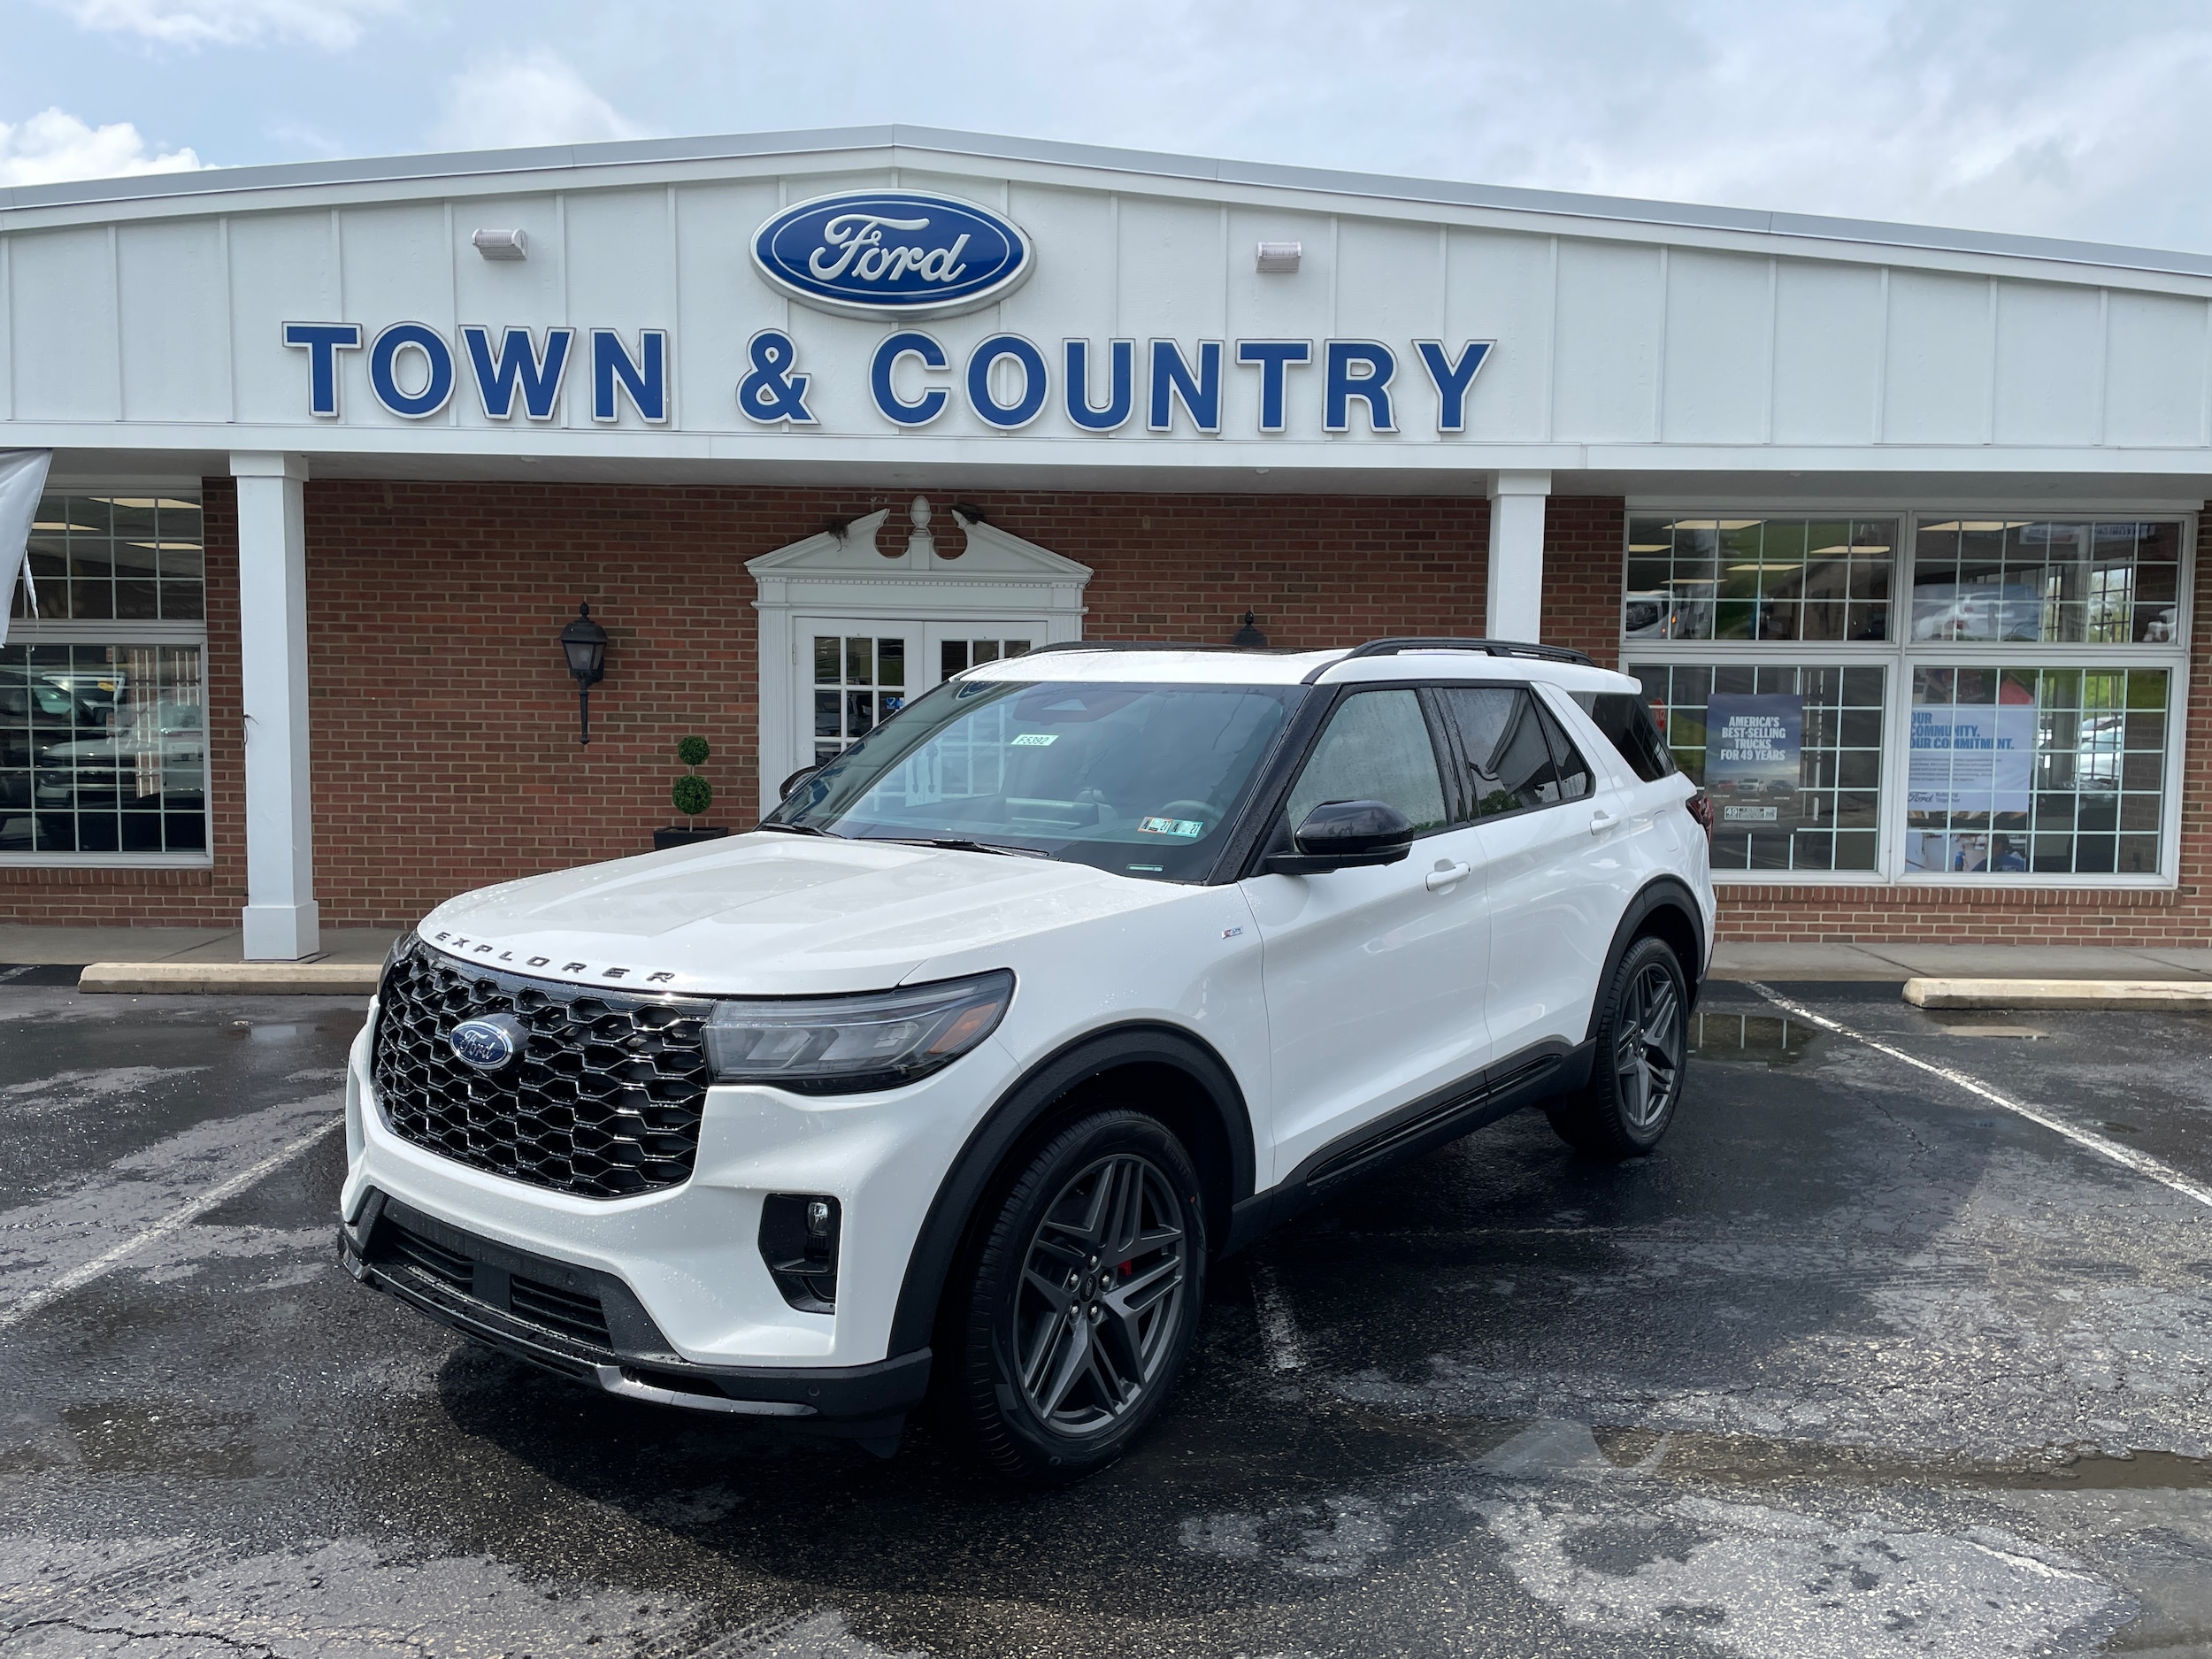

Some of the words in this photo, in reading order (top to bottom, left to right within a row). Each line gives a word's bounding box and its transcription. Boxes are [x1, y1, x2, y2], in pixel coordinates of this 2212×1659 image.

[809, 213, 971, 283] Ford
[282, 320, 668, 424] TOWN
[736, 328, 821, 426] &
[868, 328, 1498, 434] COUNTRY
[1729, 716, 1780, 727] AMERICA'S
[1722, 727, 1786, 739] BEST-SELLING
[1016, 736, 1050, 745] F5392
[1734, 739, 1772, 749] TRUCKS
[1720, 749, 1740, 760] FOR
[1740, 749, 1754, 760] 49
[1755, 749, 1786, 761] YEARS
[434, 931, 675, 984] EXPLORER
[460, 1029, 495, 1060] Ford
